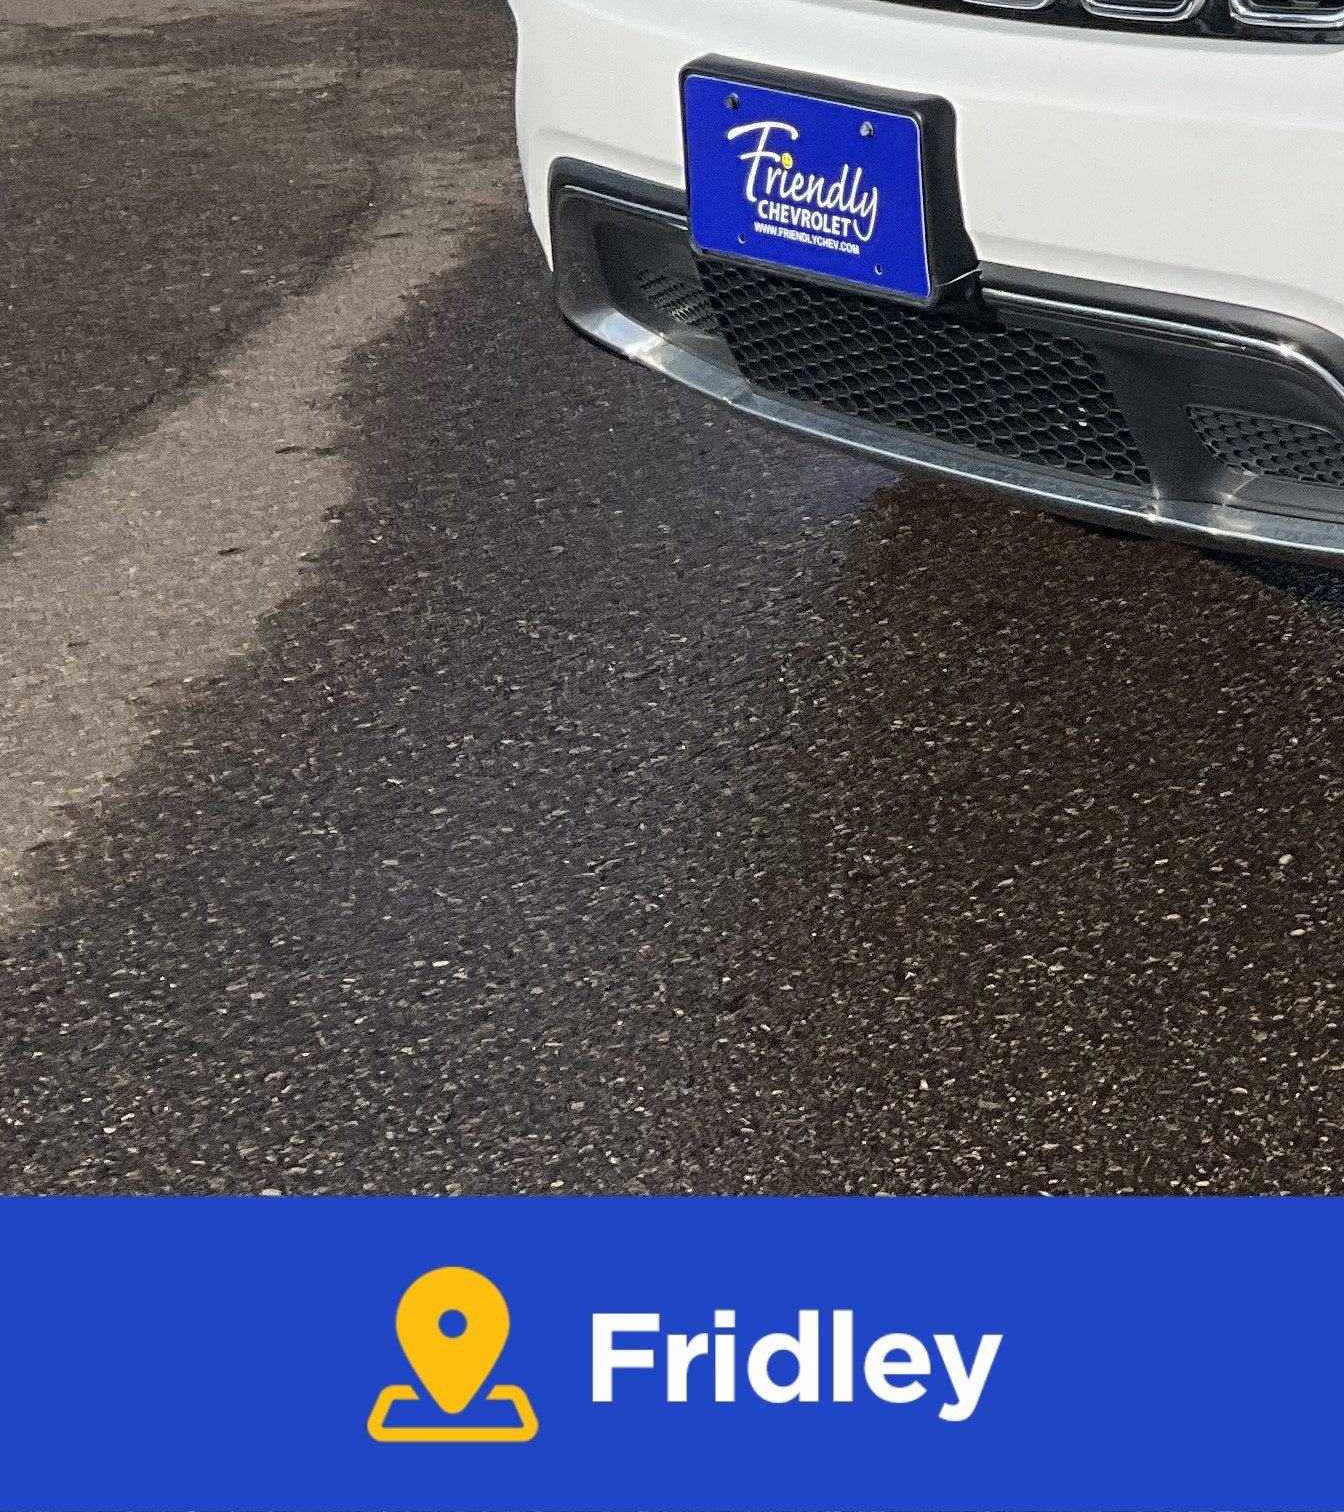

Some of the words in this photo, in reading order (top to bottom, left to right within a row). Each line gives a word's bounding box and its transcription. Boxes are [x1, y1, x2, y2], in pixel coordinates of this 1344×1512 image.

[727, 121, 878, 242] Friendly
[753, 221, 860, 255] WWW.FRIENDLYCHEV.COM
[757, 199, 852, 238] CHEVROLET
